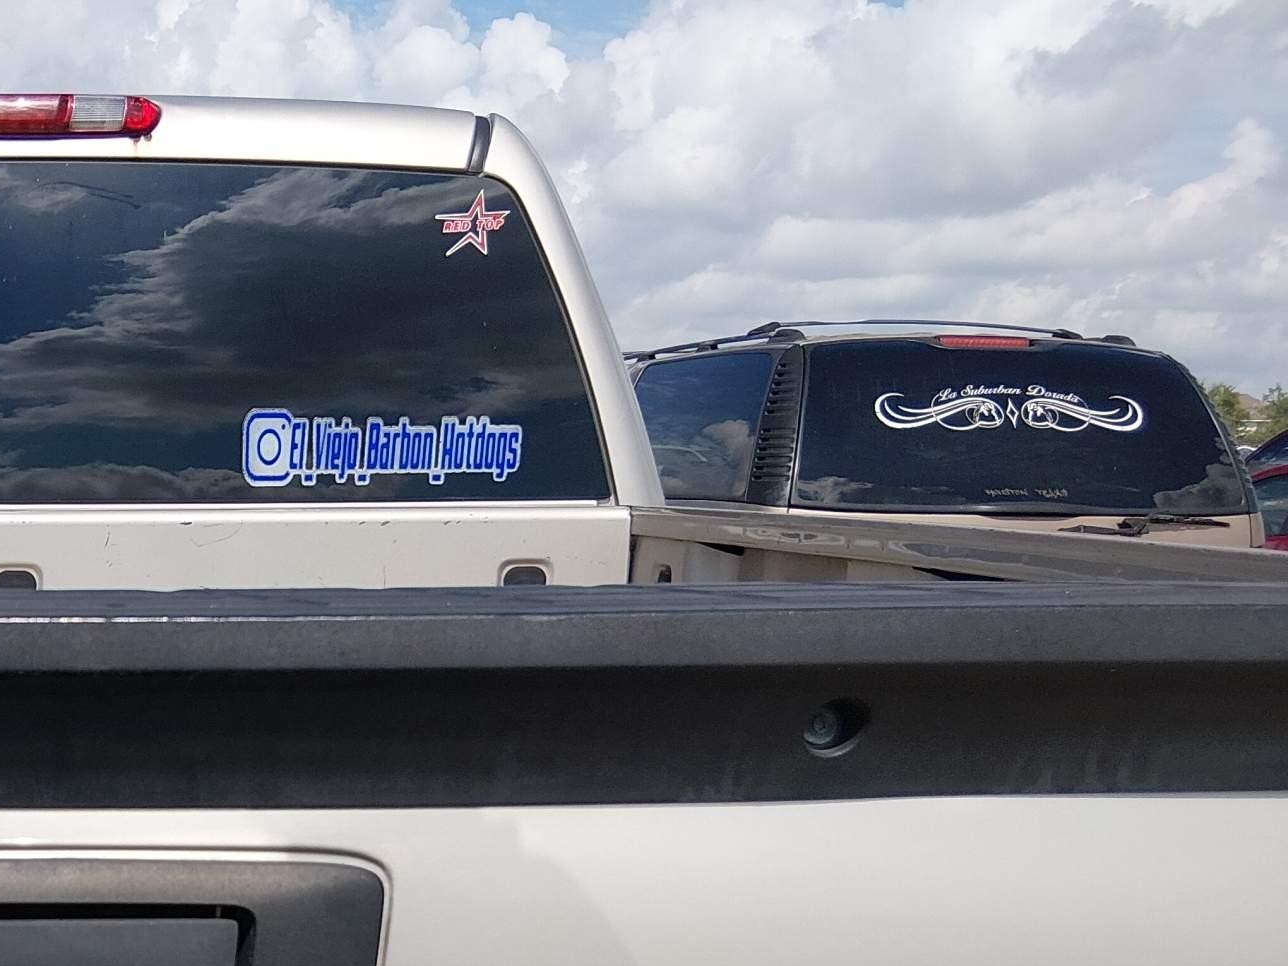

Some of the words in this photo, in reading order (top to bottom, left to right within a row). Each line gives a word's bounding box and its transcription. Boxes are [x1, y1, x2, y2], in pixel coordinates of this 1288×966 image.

[442, 220, 472, 233] RED
[476, 218, 505, 231] TOP
[937, 387, 957, 402] La
[961, 384, 1022, 397] Suburban
[1025, 384, 1080, 403] Dorada
